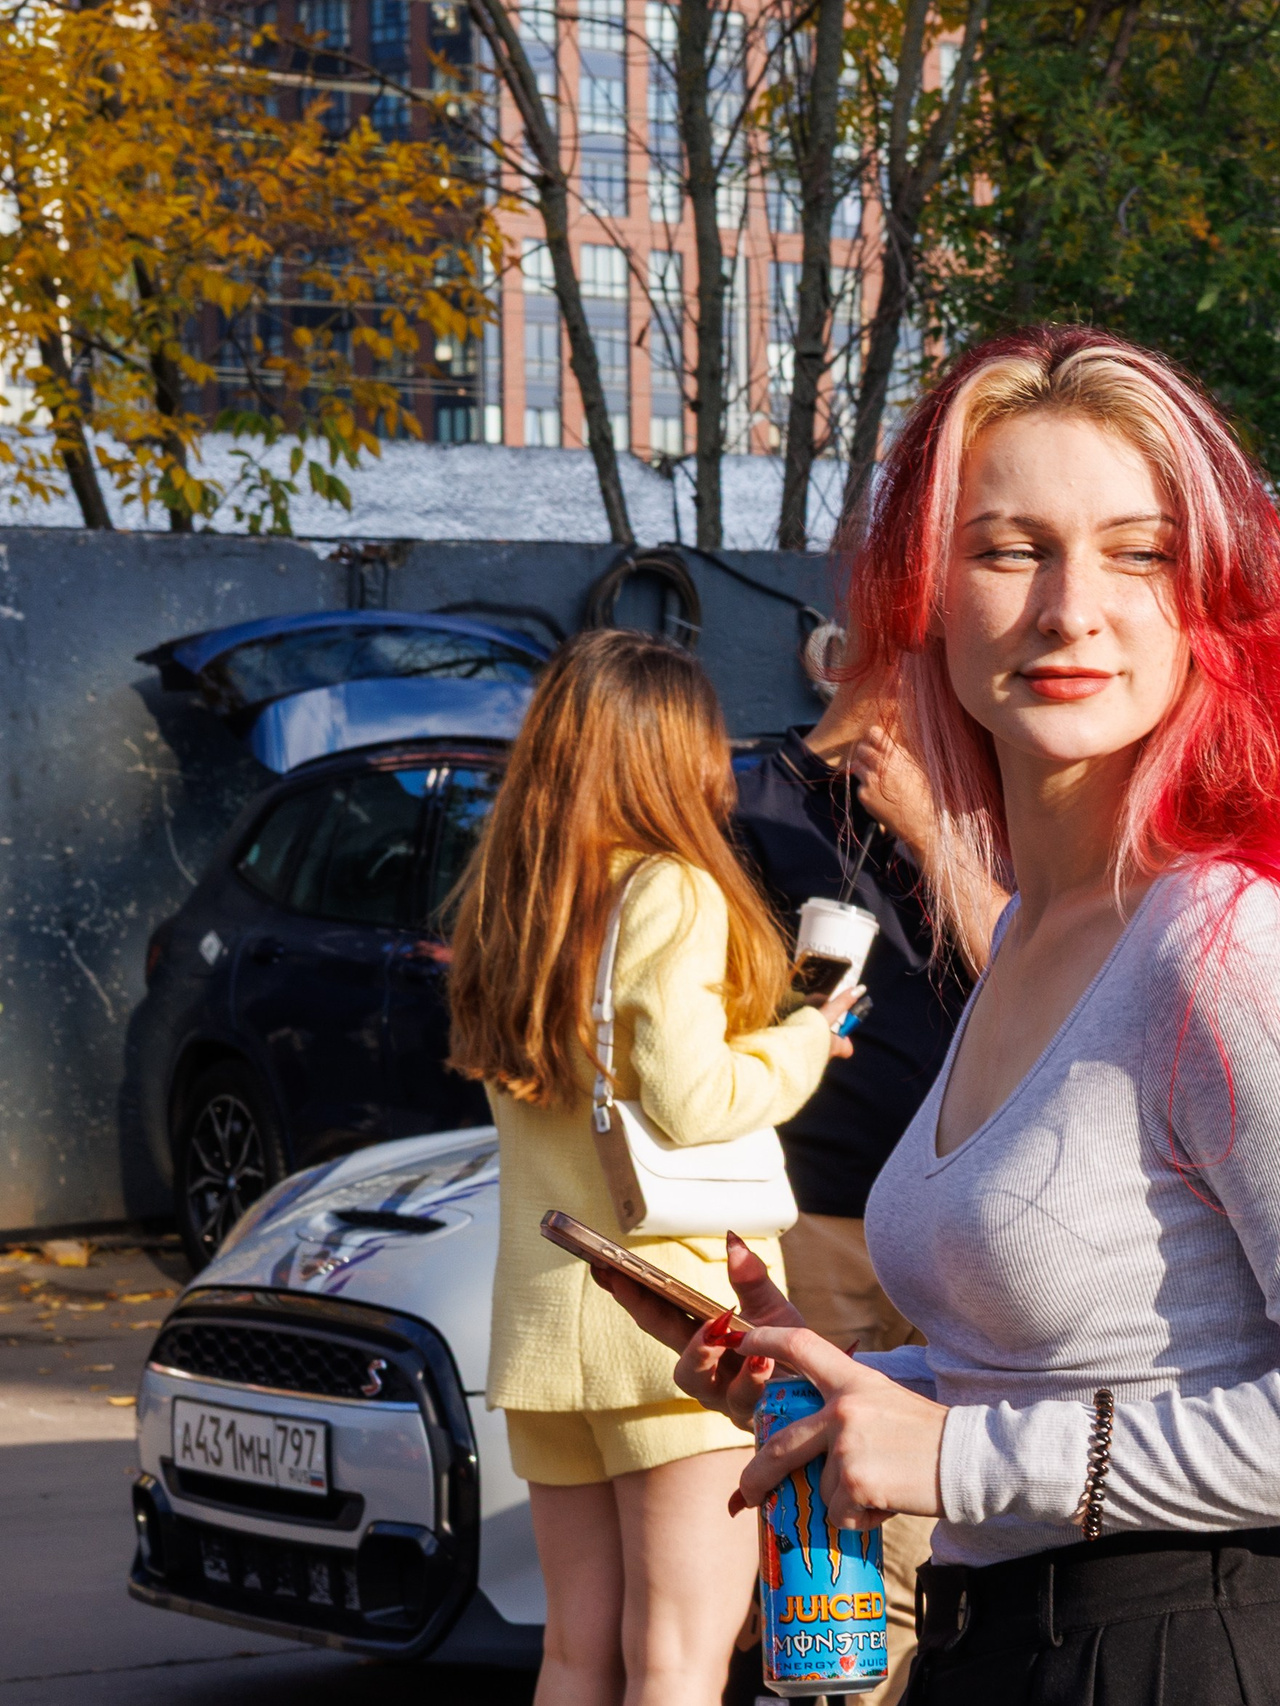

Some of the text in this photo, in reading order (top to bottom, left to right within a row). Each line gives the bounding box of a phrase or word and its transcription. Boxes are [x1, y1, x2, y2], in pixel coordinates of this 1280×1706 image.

[275, 1423, 317, 1468] 797
[779, 1591, 884, 1623] JUICED
[774, 1629, 887, 1658] MONSTER
[775, 1660, 836, 1671] ENERGY
